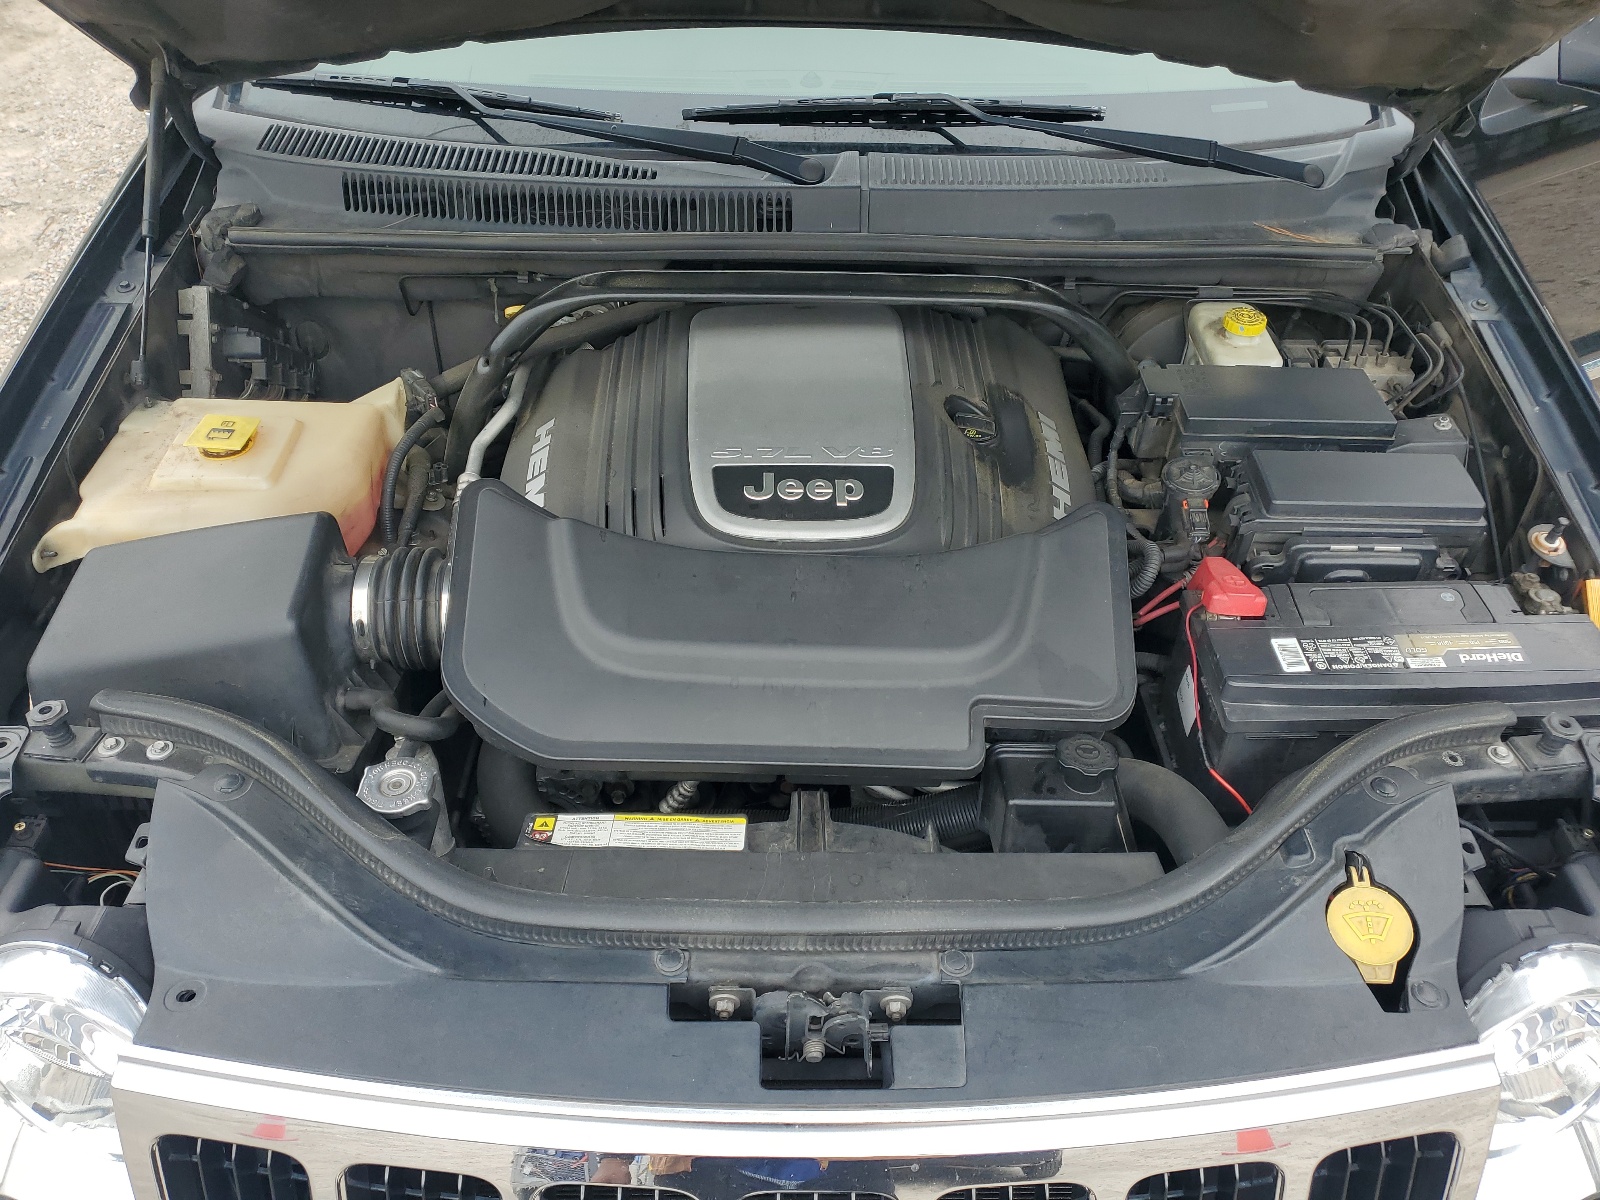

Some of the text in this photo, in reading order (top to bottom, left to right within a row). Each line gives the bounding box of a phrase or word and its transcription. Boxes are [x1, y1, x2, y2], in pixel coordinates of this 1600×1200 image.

[711, 447, 893, 458] 5.7L V8
[744, 472, 864, 507] Jeep
[1459, 652, 1524, 664] DieHard
